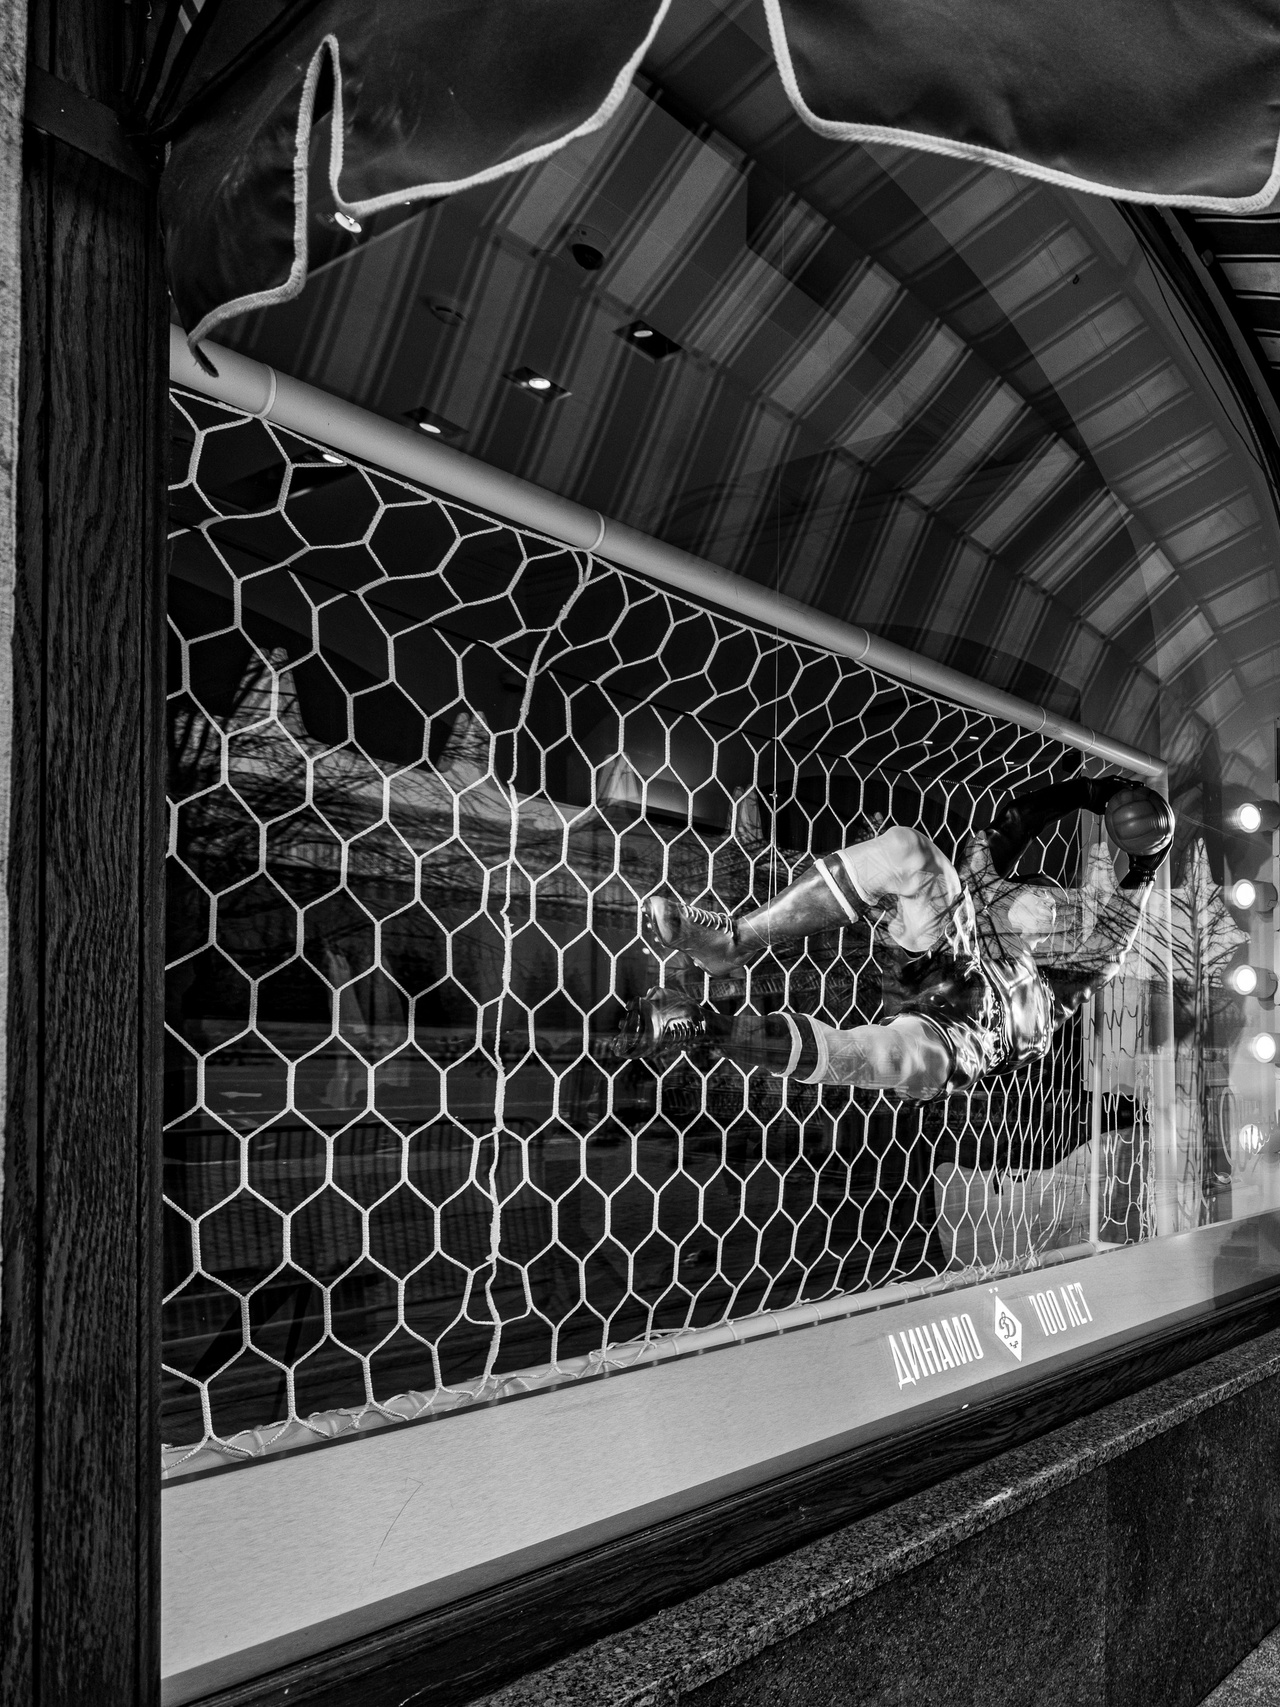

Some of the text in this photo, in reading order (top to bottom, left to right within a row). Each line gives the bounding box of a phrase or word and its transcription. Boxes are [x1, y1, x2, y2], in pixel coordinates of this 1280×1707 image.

[888, 1282, 1093, 1391] ДИНАМО 100 ЛЕТ
